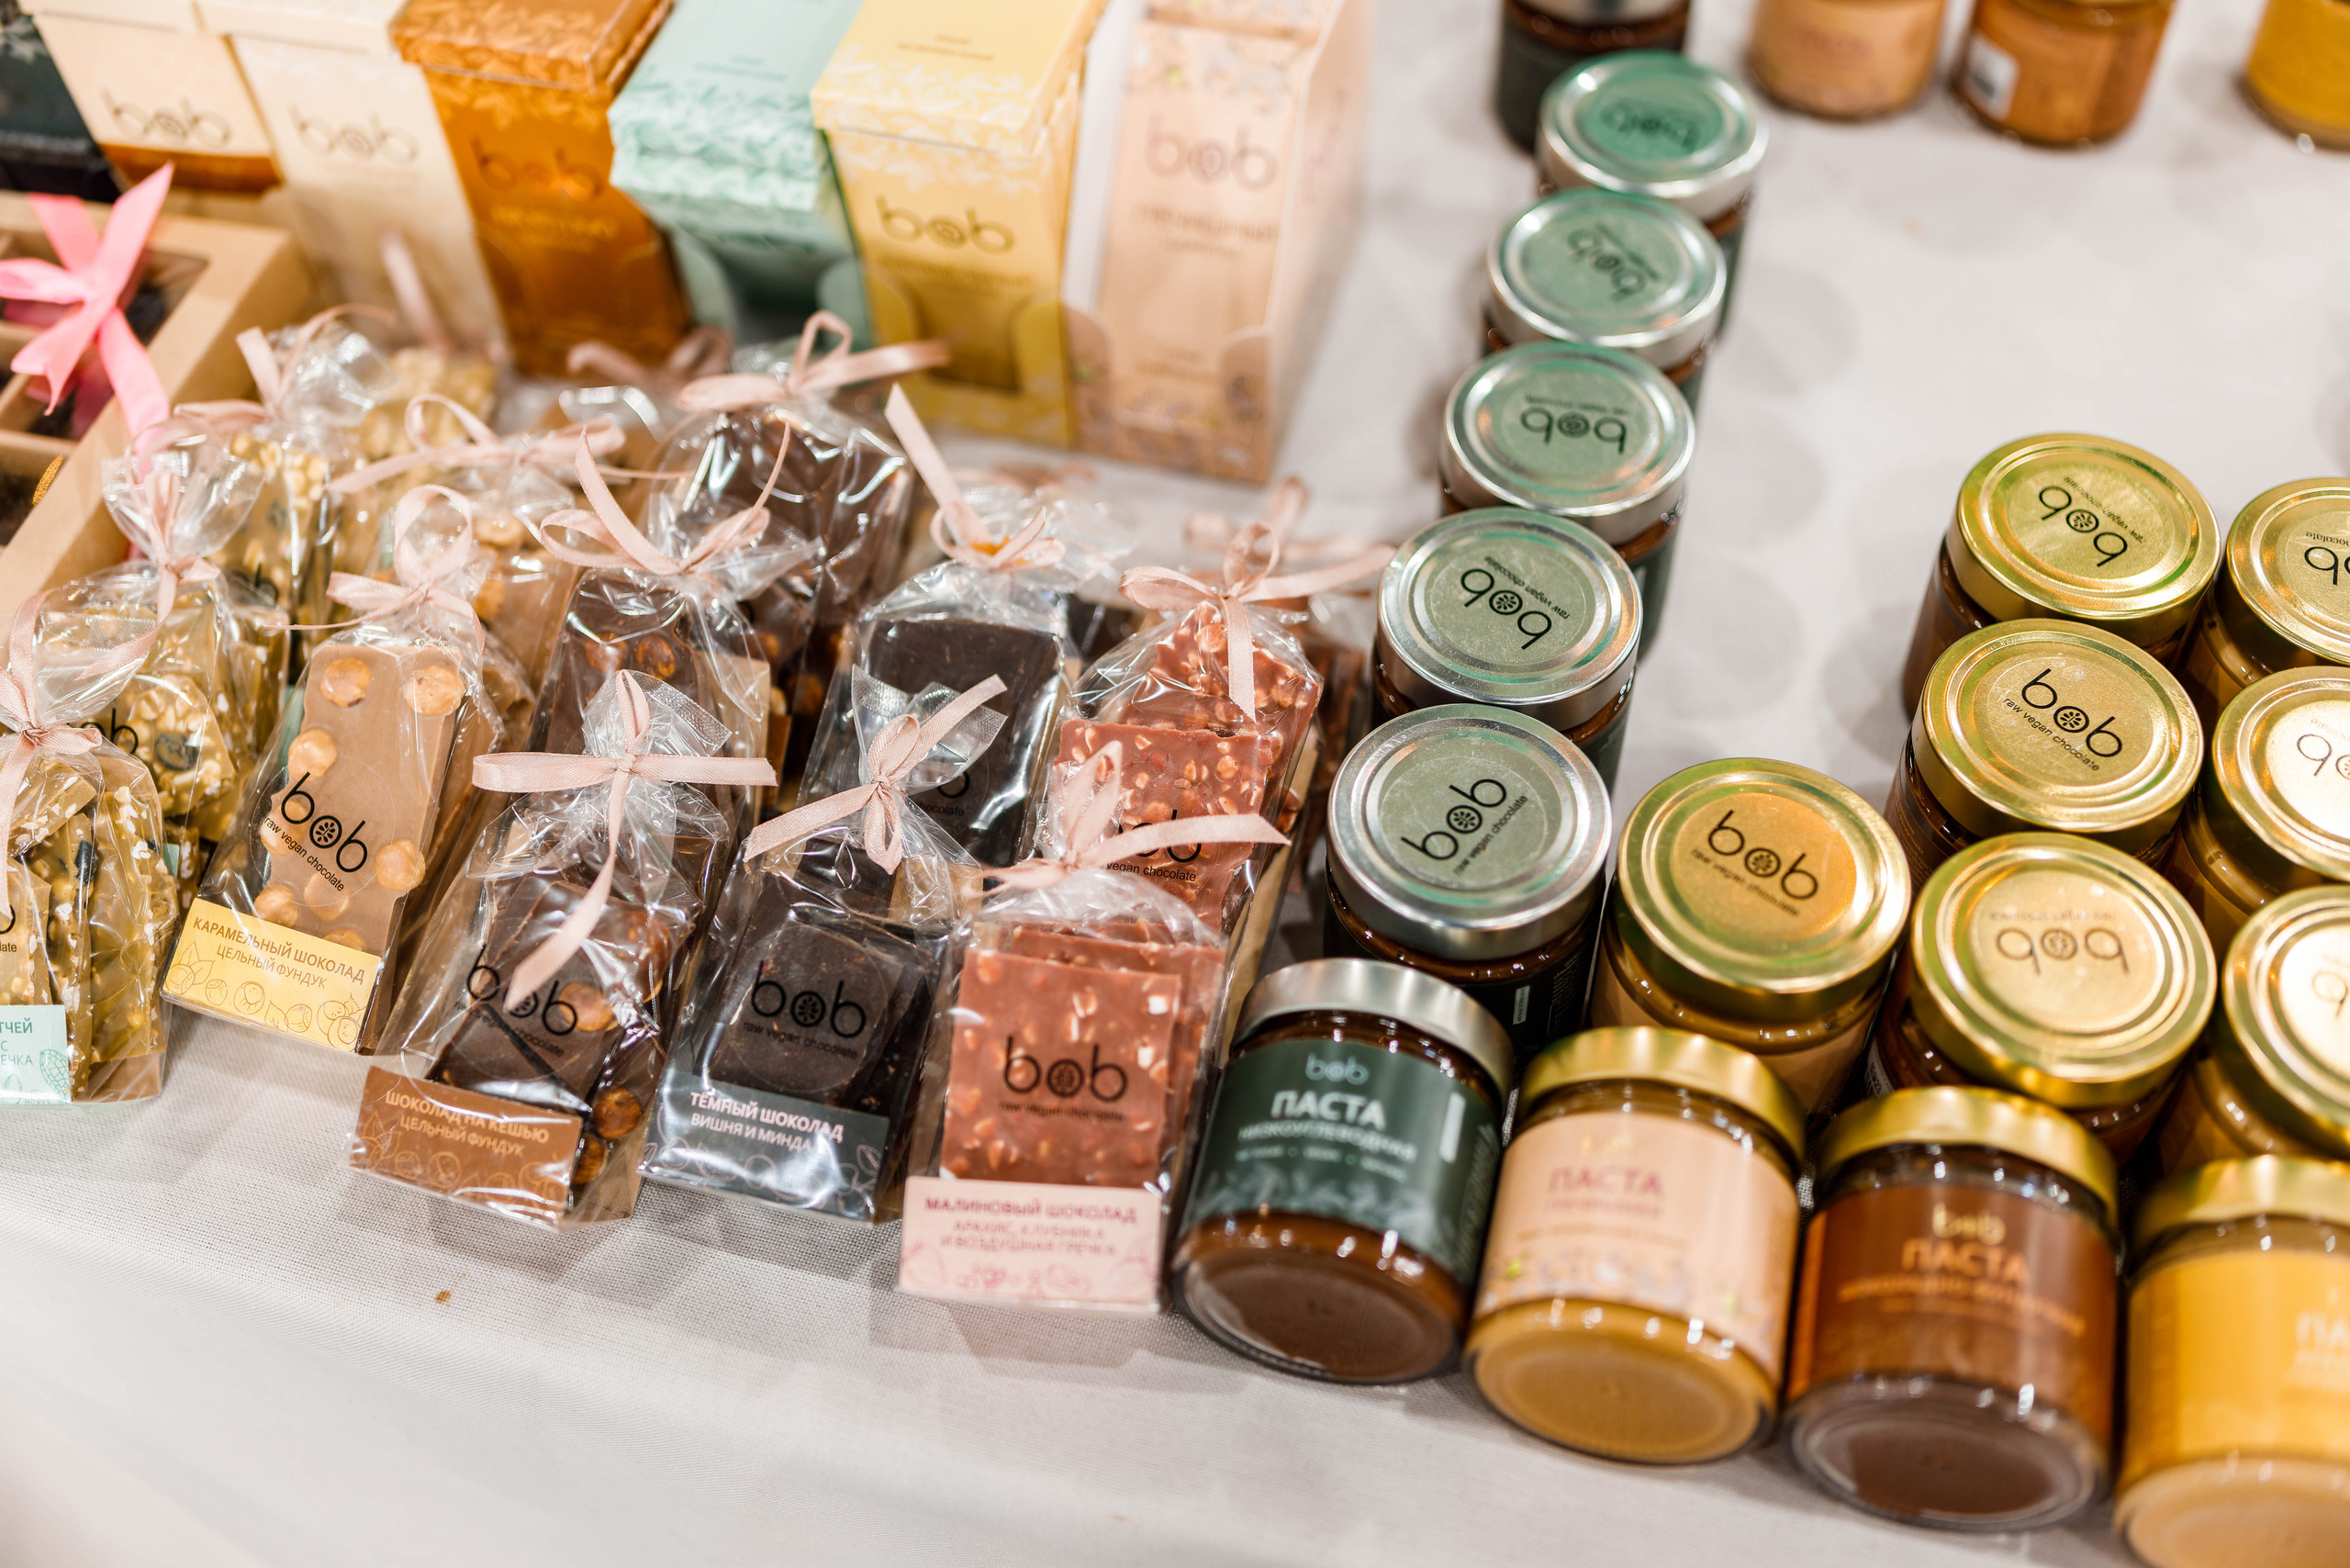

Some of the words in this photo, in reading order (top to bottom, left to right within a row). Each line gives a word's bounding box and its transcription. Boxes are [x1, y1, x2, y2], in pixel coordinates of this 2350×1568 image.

[99, 86, 232, 149] bob
[1145, 115, 1280, 192] bob
[875, 195, 1014, 255] bob
[1520, 407, 1628, 454] bob
[2039, 486, 2128, 567] bob
[2305, 532, 2350, 547] ocolate
[1484, 556, 1526, 587] chocolate
[1460, 568, 1552, 650] bob
[1525, 586, 1551, 608] vegan
[1551, 605, 1571, 620] raw
[2003, 697, 2023, 713] raw
[2022, 712, 2053, 736] vegan
[2053, 735, 2100, 771] chocolate
[2021, 668, 2122, 757] bob
[281, 771, 368, 873] bob
[919, 801, 965, 817] hocolate
[1401, 778, 1506, 860] bob
[1470, 833, 1494, 859] vegan
[1491, 795, 1528, 834] chocolate
[264, 817, 282, 834] raw
[281, 832, 308, 857] vegan
[307, 855, 344, 891] chocolate
[1106, 862, 1140, 874] vegan
[1143, 866, 1196, 882] chocolate
[1707, 809, 1818, 900] bob
[193, 916, 292, 959] КАРАМЕЛЬНЫЙ
[293, 948, 365, 985] ШОКОЛАД
[217, 944, 276, 971] ЦЕЛЬНЫЙ
[276, 964, 328, 990] ФУНДУК
[1997, 927, 2129, 975] bob
[751, 959, 866, 1038] bob
[1, 1054, 34, 1066] ЕЧКА
[1003, 1036, 1128, 1103] bob
[1305, 1053, 1369, 1085] bob
[385, 1091, 460, 1126] ШОКОЛАД
[464, 1113, 486, 1128] НА
[488, 1118, 550, 1144] КЕШЬЮ
[690, 1113, 744, 1138] ВИШНЯ
[744, 1125, 757, 1138] И
[758, 1128, 813, 1152] МИНДА
[759, 1108, 845, 1143] ШОКОЛАД
[1270, 1091, 1385, 1131] ПАСТА
[399, 1114, 466, 1144] ЦЕЛЬНЫЙ
[467, 1133, 526, 1158] ФУНДУК
[1548, 1166, 1663, 1197] ПАСТА
[924, 1196, 1042, 1216] МАЛИНОВЫЙ
[1046, 1204, 1137, 1224] ШОКОЛАД
[1902, 1238, 2029, 1284] ПАСТА
